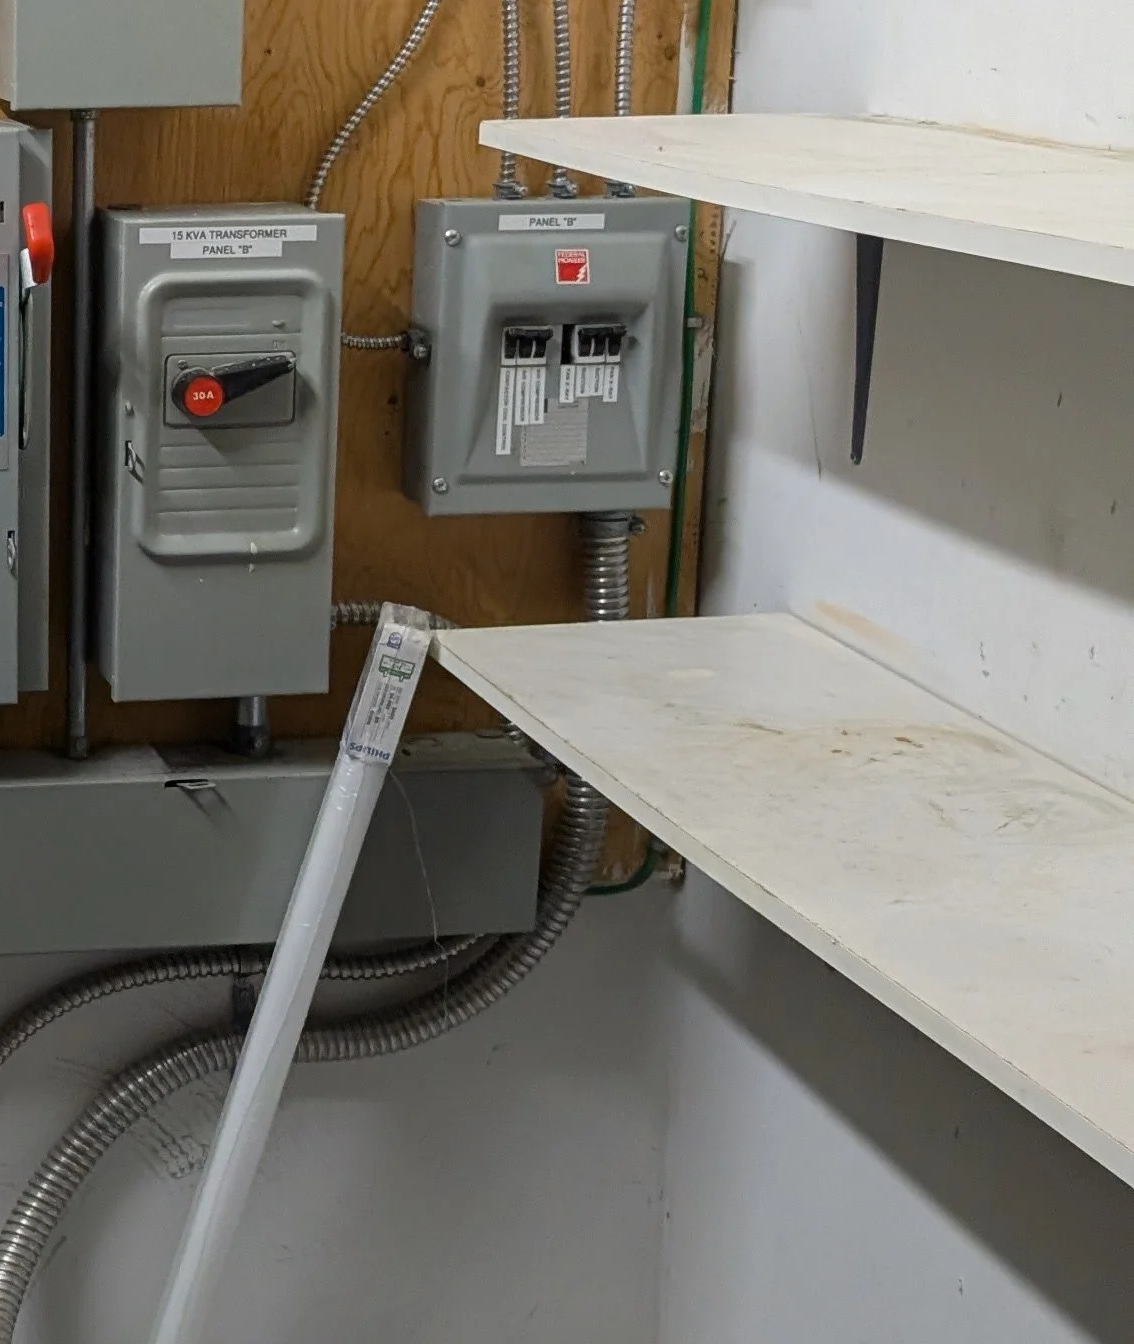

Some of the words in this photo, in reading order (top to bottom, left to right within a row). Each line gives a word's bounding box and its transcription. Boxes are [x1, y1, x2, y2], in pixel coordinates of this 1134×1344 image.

[528, 217, 562, 227] PANEL
[563, 217, 577, 227] "B"
[171, 230, 184, 241] 15
[185, 229, 208, 240] KVA
[209, 228, 288, 240] TRANSFORMER
[202, 244, 236, 255] PANEL
[237, 244, 253, 255] "B"
[192, 390, 215, 401] 30A
